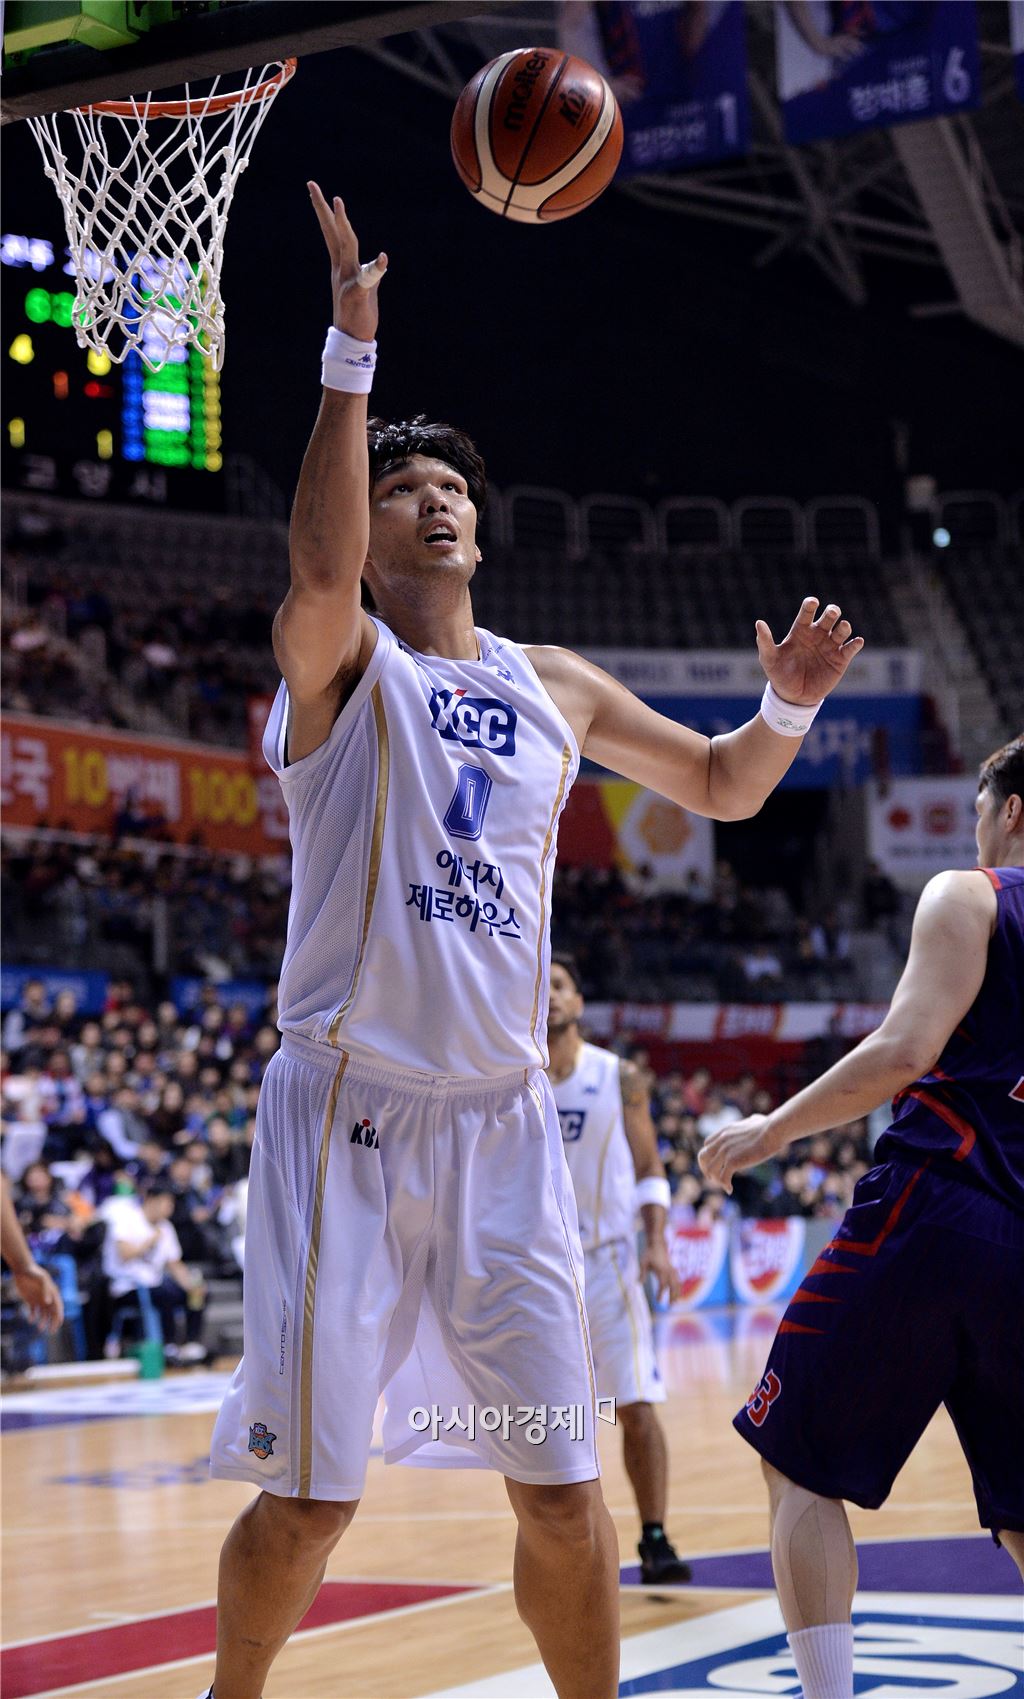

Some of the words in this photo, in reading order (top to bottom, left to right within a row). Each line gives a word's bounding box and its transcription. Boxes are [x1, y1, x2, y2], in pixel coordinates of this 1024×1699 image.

[943, 47, 971, 104] 6
[714, 94, 738, 146] 1
[434, 688, 510, 750] KCC
[443, 763, 493, 842] 0
[436, 849, 504, 900] 에너지
[405, 883, 521, 939] 제로하우스
